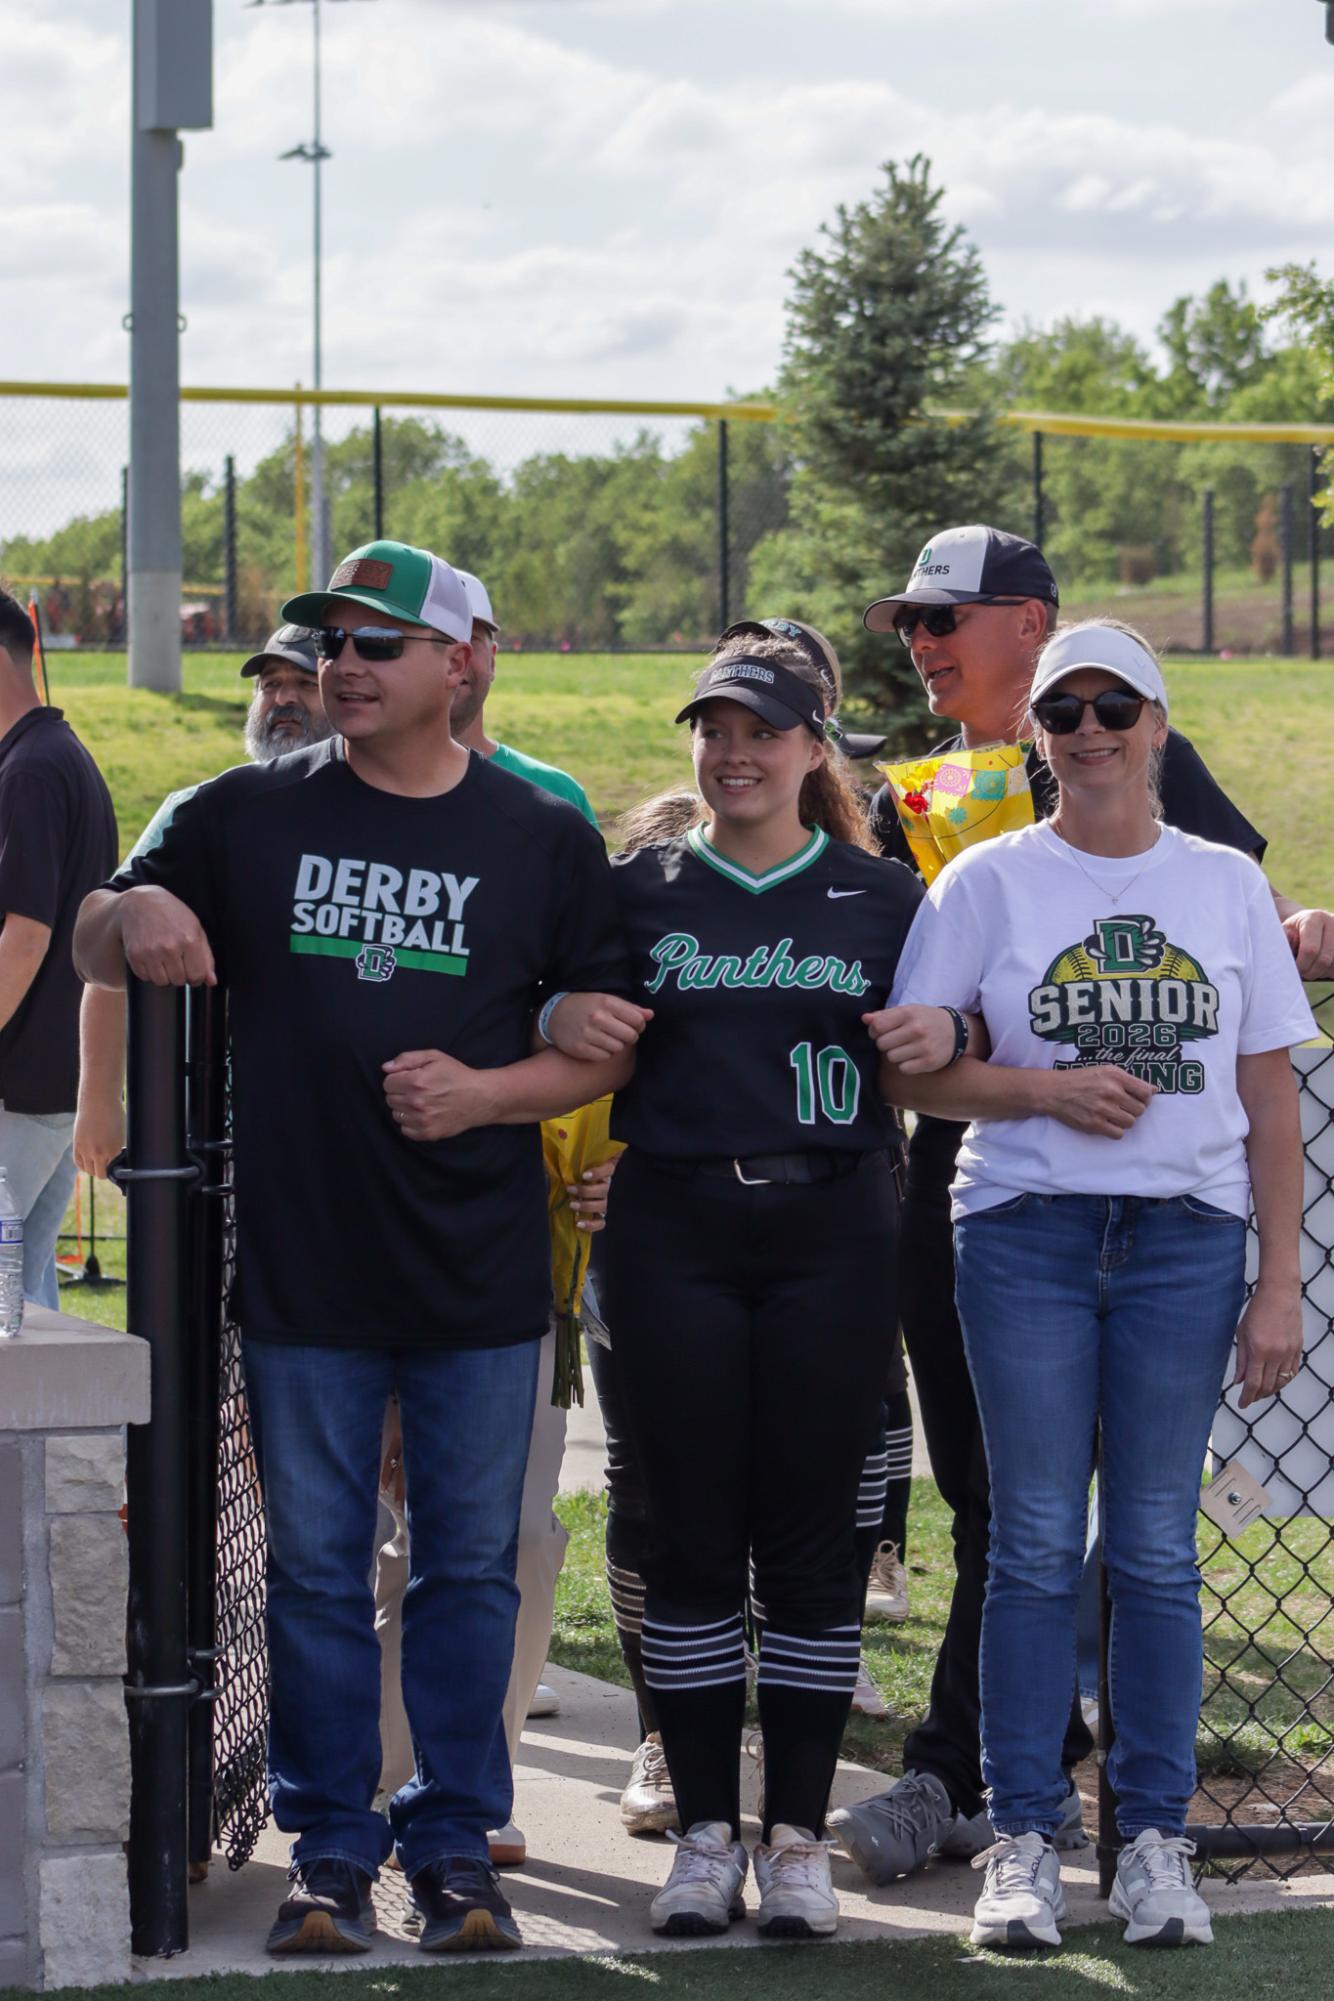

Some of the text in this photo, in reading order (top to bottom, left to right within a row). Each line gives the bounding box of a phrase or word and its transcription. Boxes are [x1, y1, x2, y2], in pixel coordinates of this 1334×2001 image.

[913, 564, 951, 578] THERS
[709, 664, 775, 684] PANTHERS
[294, 854, 480, 921] DERBY
[290, 902, 470, 956] SOFTBALL
[1093, 917, 1150, 974] D
[644, 933, 871, 996] Panthers
[1030, 979, 1219, 1033] SENIOR
[1078, 1024, 1177, 1046] 2026
[1123, 1046, 1181, 1065] final
[790, 1042, 860, 1125] 10
[1055, 1062, 1204, 1093] ING
